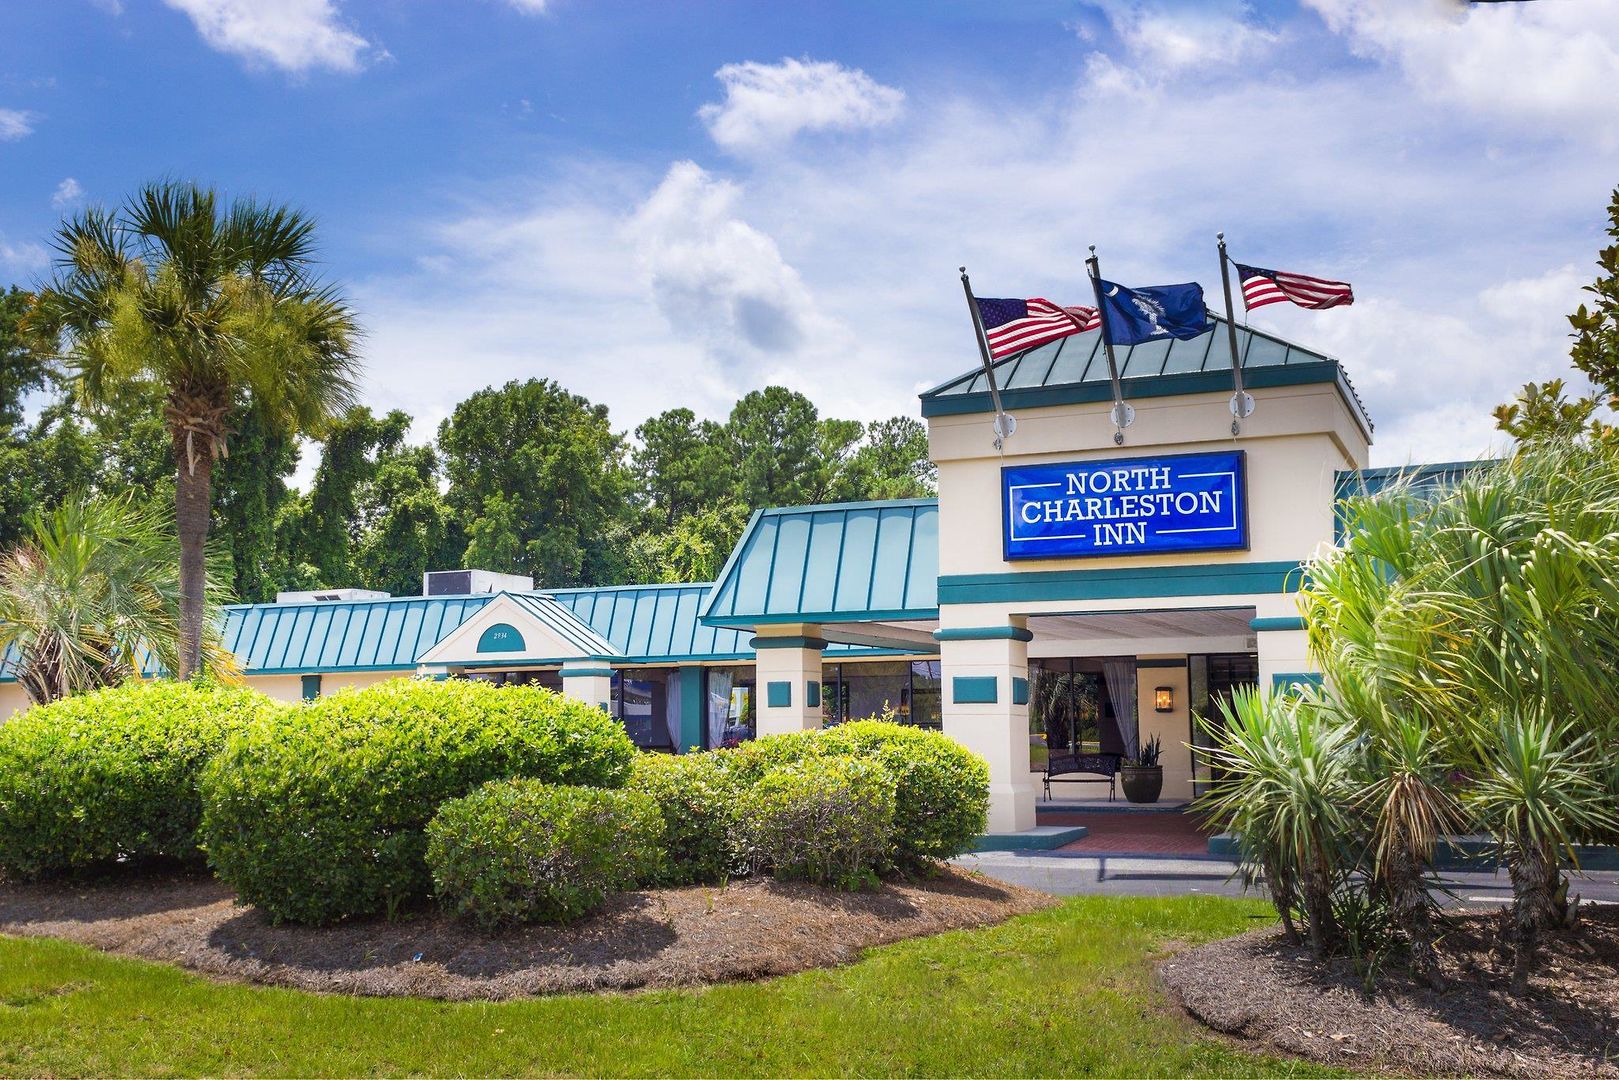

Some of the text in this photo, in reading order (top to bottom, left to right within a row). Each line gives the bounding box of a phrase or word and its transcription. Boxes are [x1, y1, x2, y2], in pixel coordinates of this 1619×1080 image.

[1066, 467, 1172, 495] NORTH
[1021, 490, 1223, 524] CHARLESTON
[1093, 522, 1147, 546] INN
